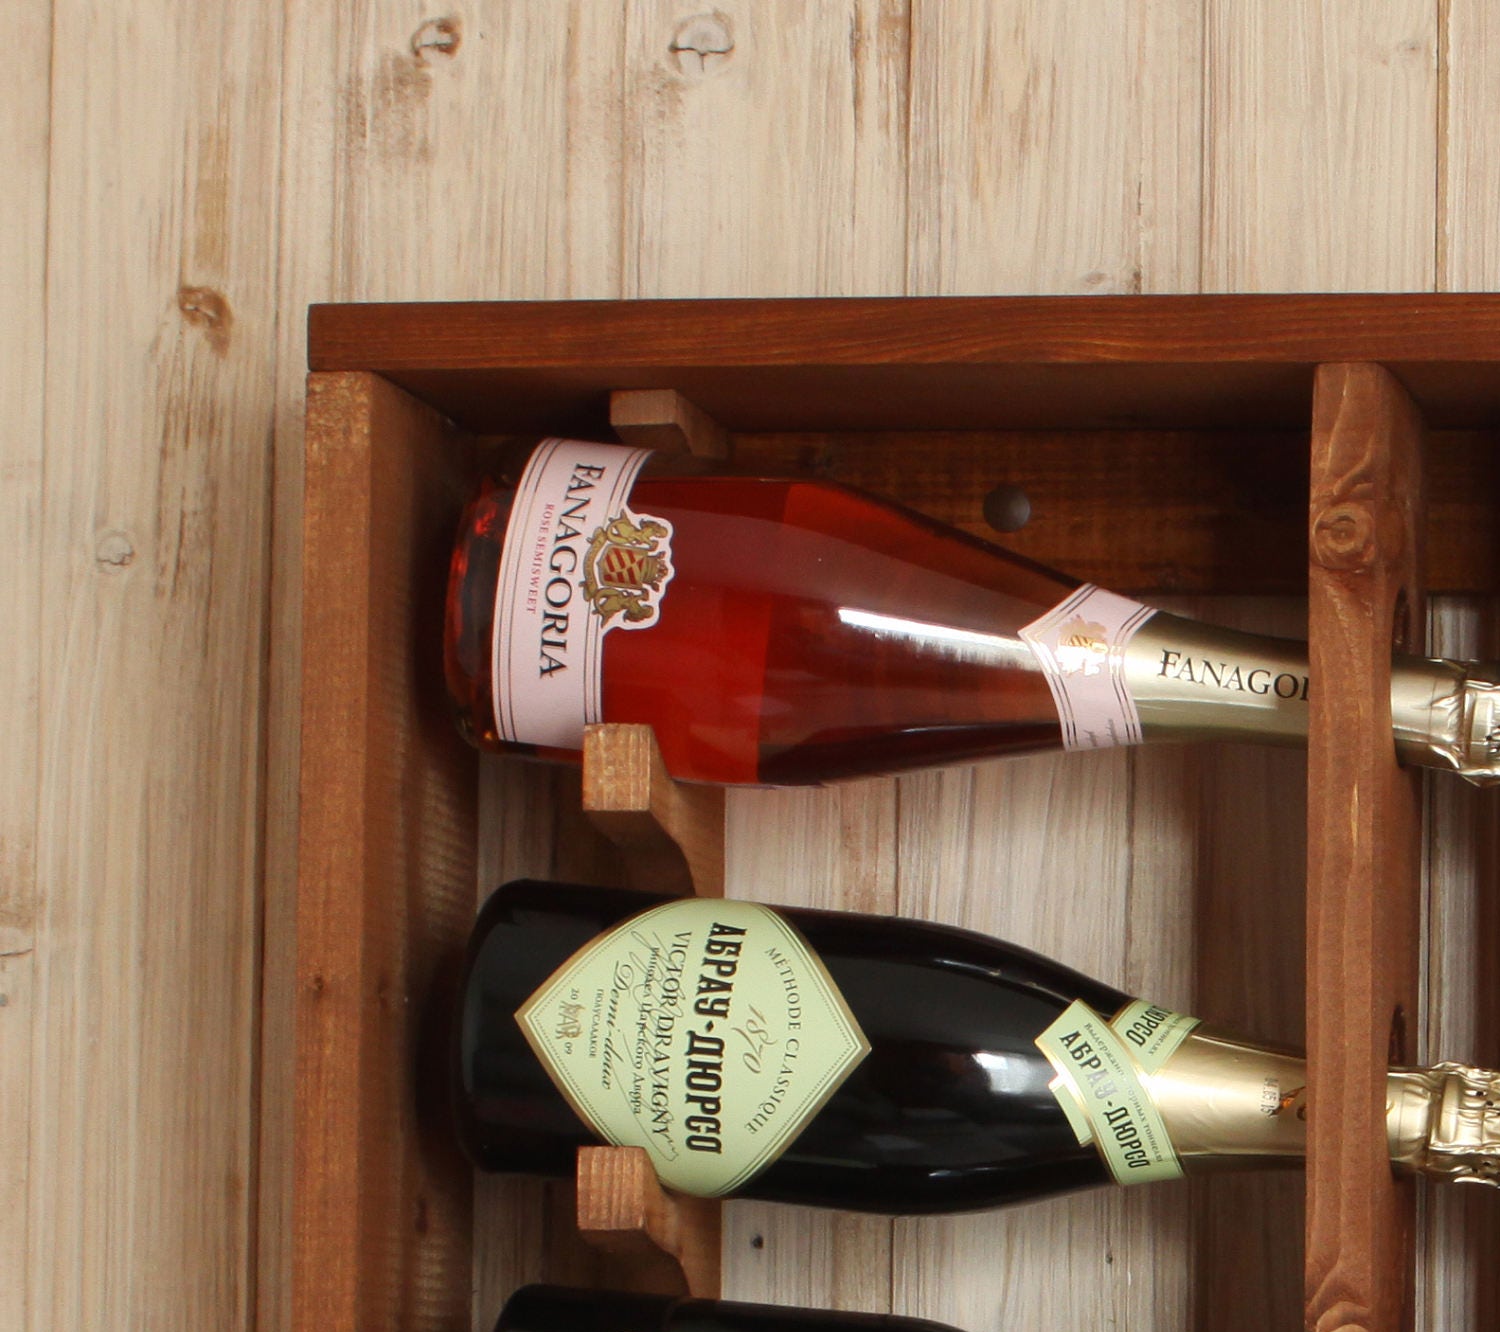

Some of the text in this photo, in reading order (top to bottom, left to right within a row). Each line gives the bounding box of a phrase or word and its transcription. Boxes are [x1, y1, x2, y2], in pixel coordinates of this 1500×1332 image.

[526, 503, 554, 614] ROSE SEMISWEET
[539, 463, 606, 680] FANAGORIA
[601, 960, 635, 1090] Demi-doux
[635, 1003, 651, 1070] Царского
[651, 931, 692, 1139] VICTOR DRAVIGNY
[731, 1003, 778, 1074] 1870
[744, 1038, 800, 1134] CLASSIQUE
